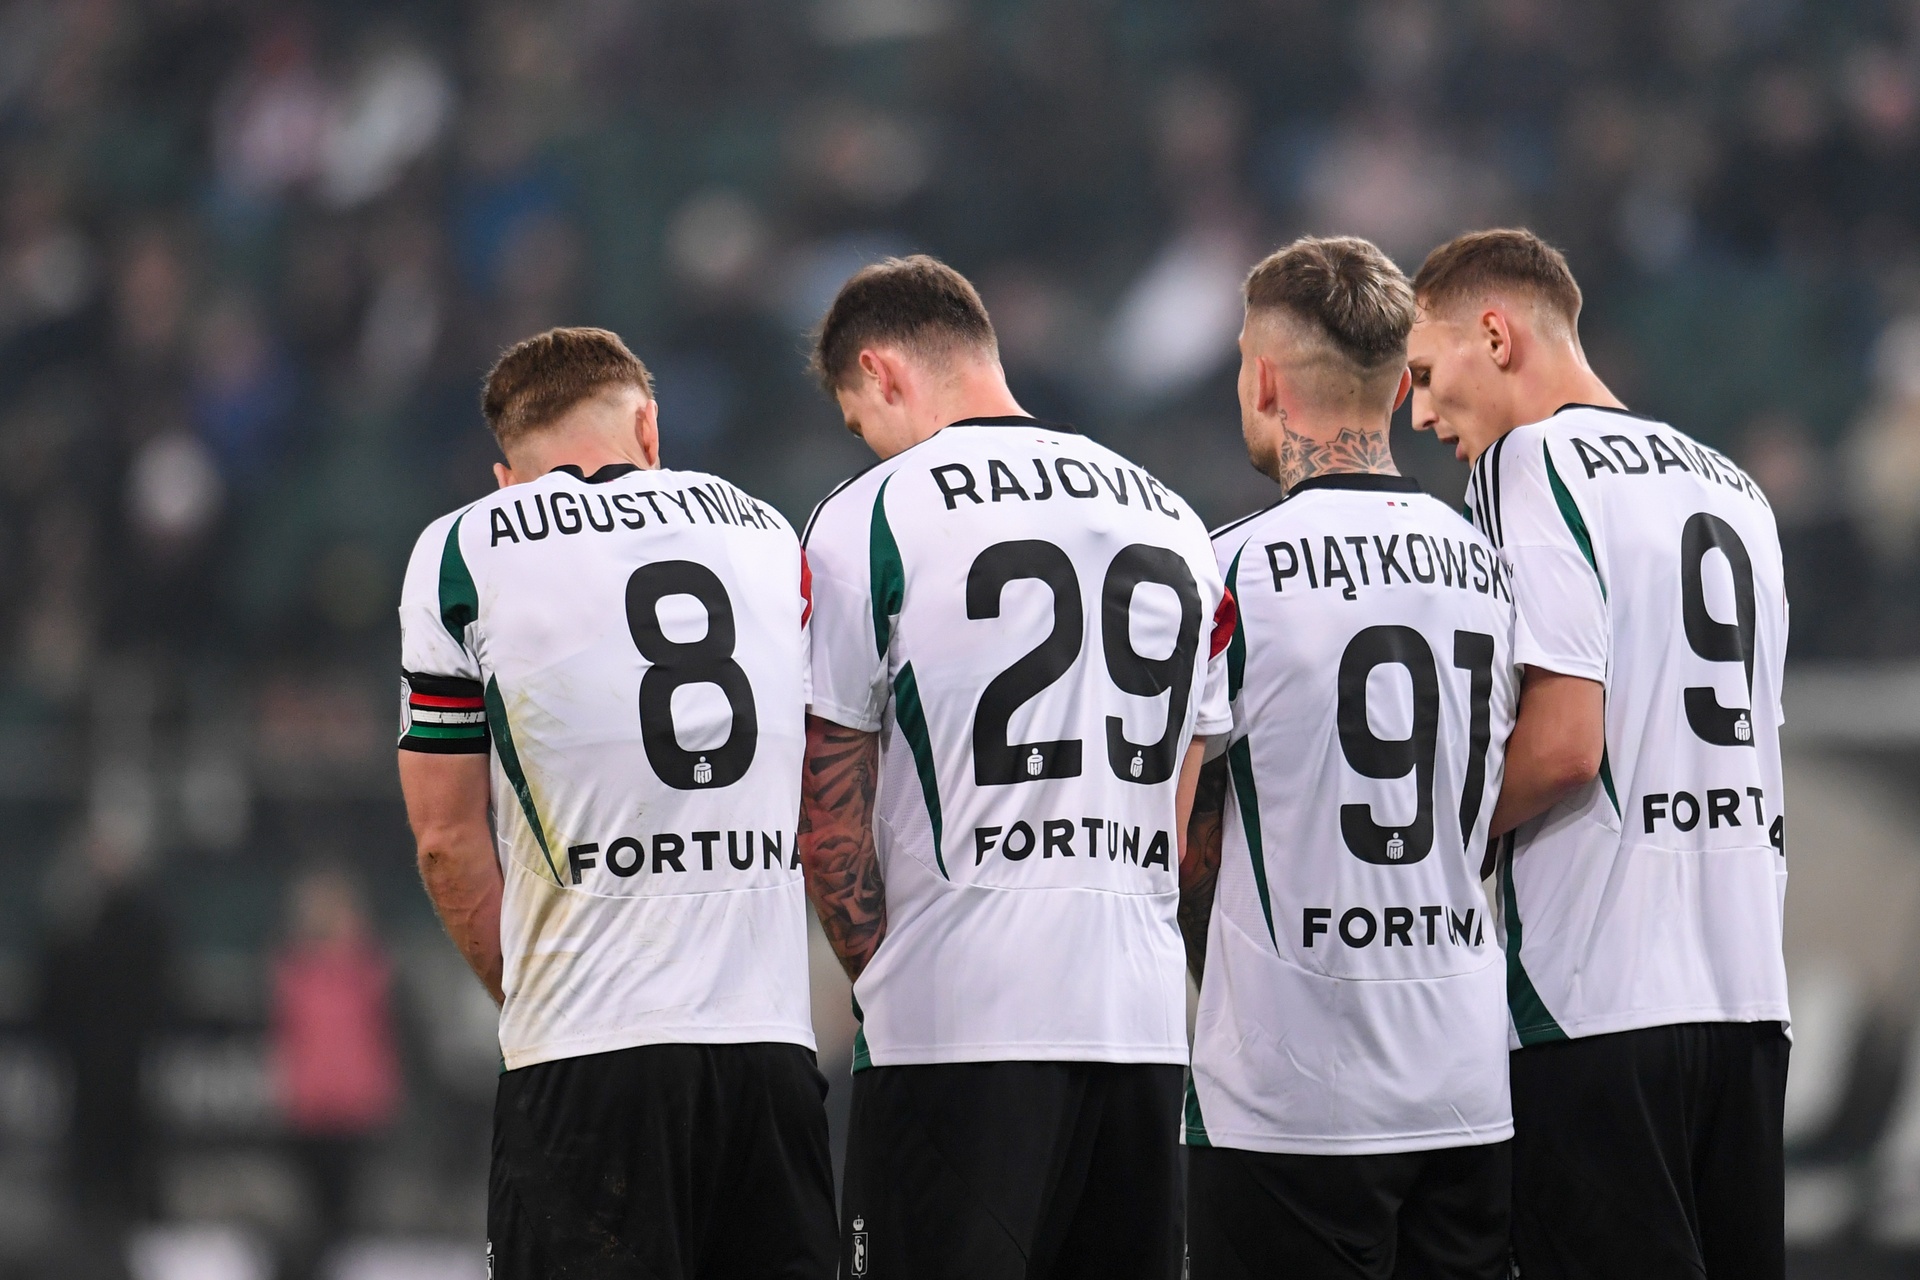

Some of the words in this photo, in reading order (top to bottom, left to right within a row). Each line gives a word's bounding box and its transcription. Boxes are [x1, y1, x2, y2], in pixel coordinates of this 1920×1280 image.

[490, 483, 781, 548] AUGUSTYNIAK
[1680, 512, 1756, 748] 9
[625, 559, 759, 790] 8
[965, 539, 1203, 786] 29
[1336, 624, 1495, 866] 91
[974, 817, 1170, 872] FORTUNA
